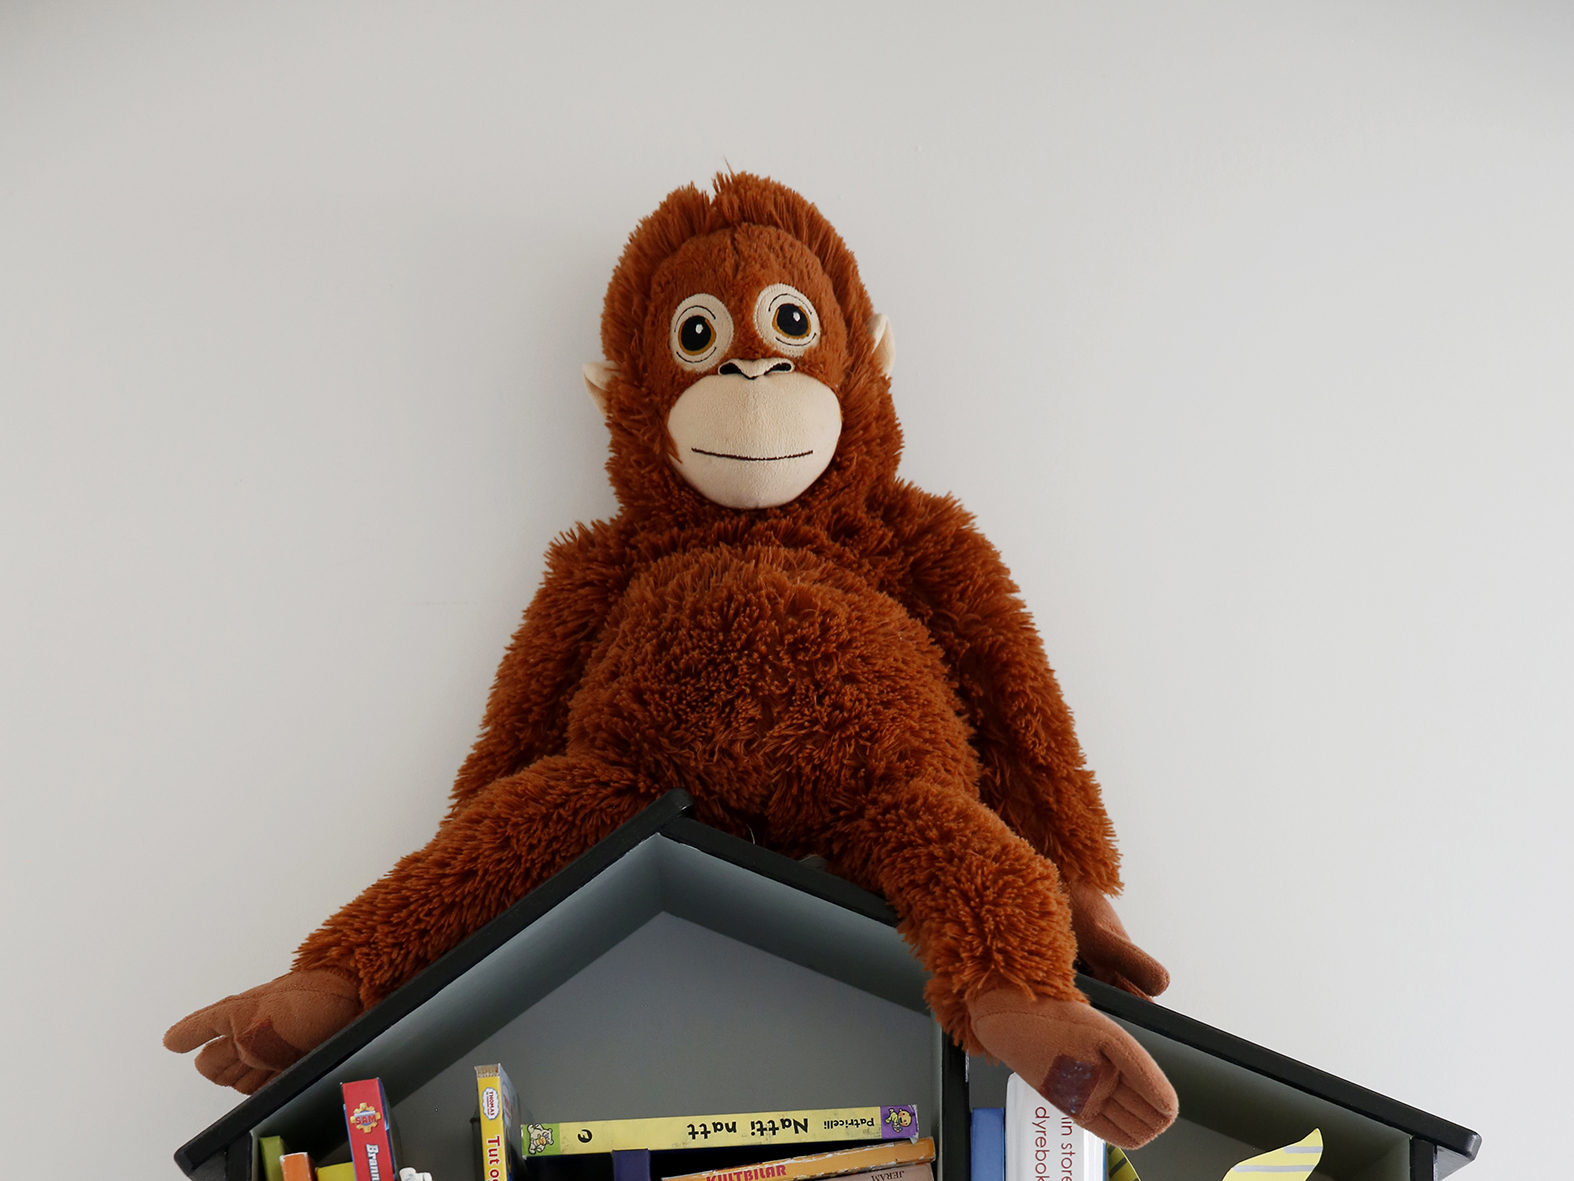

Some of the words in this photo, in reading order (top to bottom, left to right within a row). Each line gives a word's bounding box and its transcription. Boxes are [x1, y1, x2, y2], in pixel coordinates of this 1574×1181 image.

[355, 1115, 377, 1125] SAM
[750, 1118, 809, 1136] Natti
[823, 1117, 875, 1130] Patricelli
[1061, 1116, 1073, 1136] in
[687, 1121, 738, 1140] natt
[487, 1135, 500, 1165] Tut
